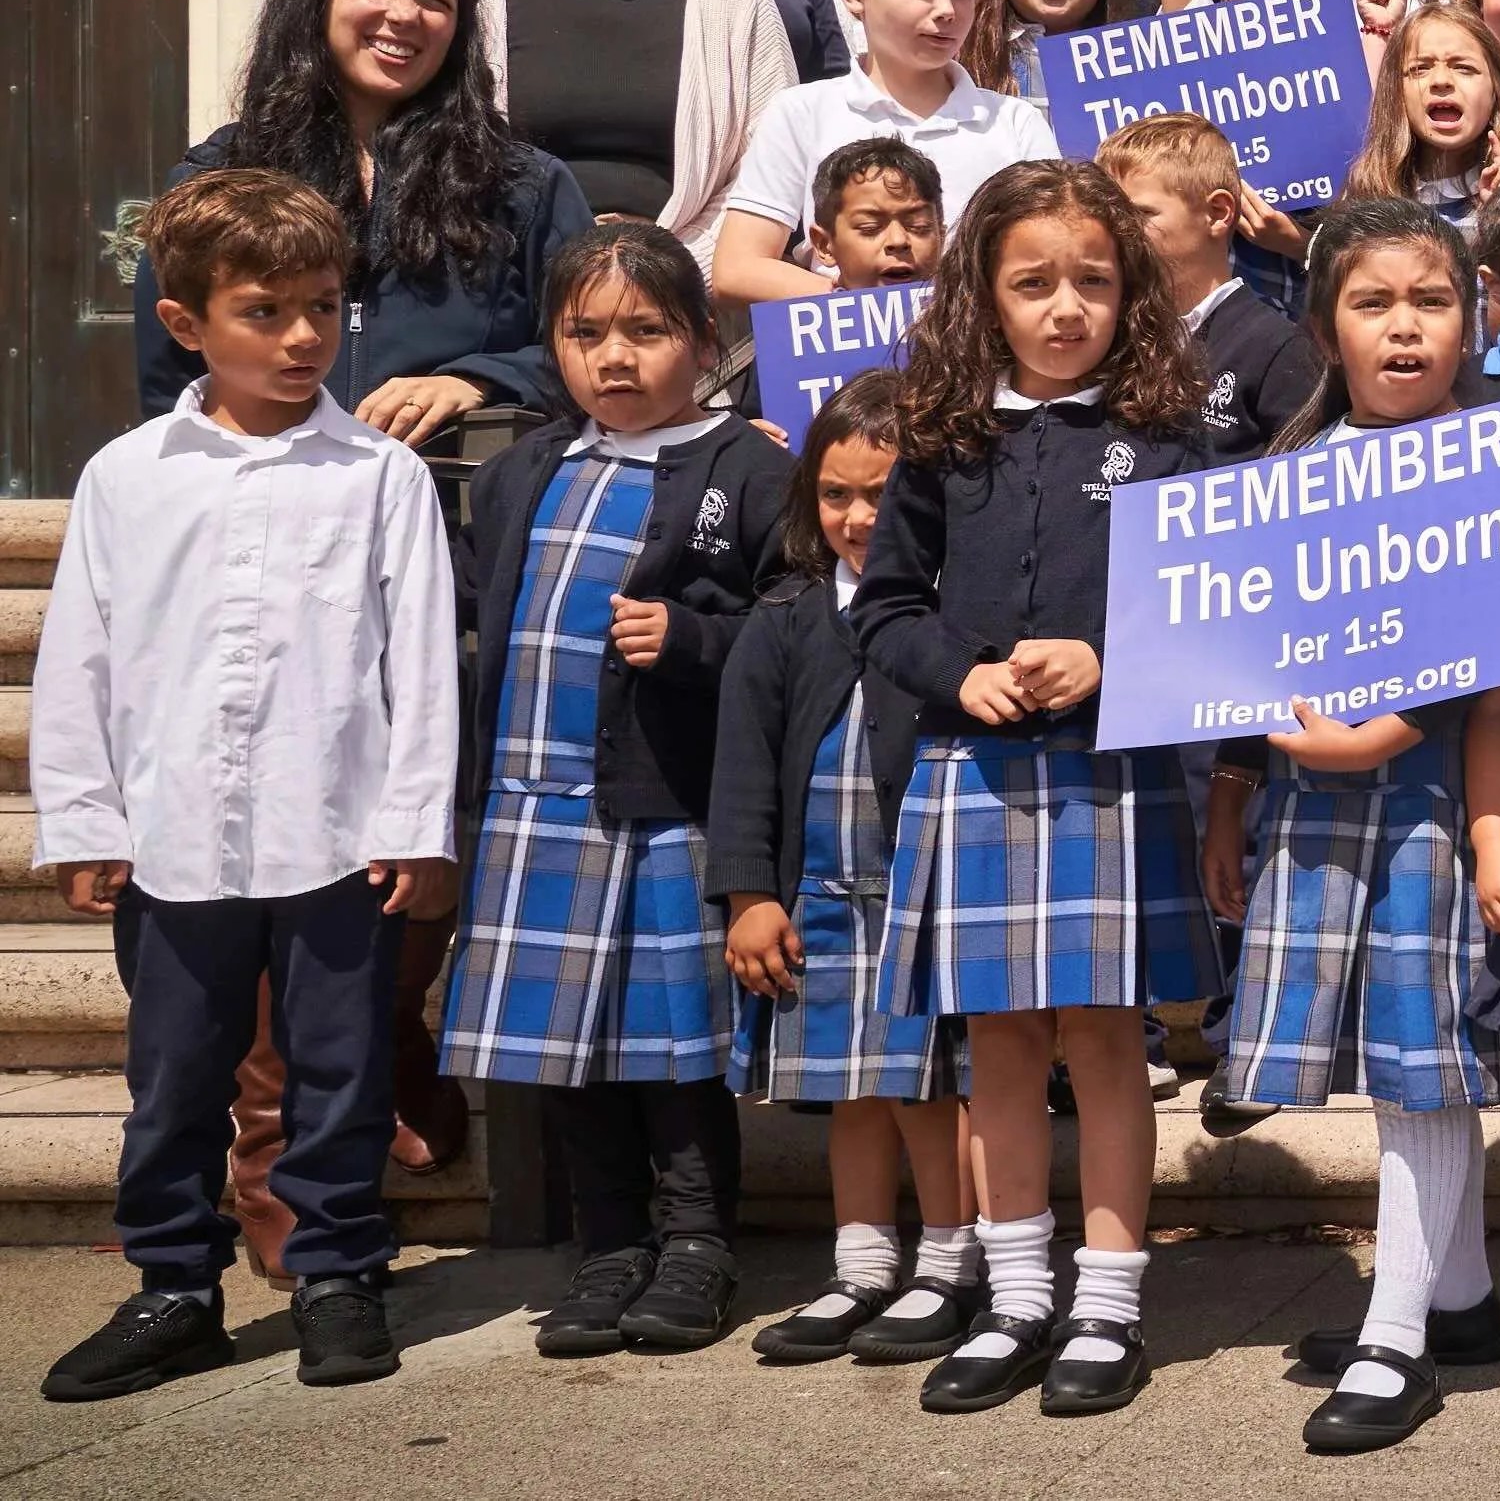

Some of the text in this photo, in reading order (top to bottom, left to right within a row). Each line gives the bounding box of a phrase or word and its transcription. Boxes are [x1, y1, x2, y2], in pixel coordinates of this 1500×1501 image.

[1158, 562, 1273, 626] The
[1274, 608, 1405, 669] Jer 1:5
